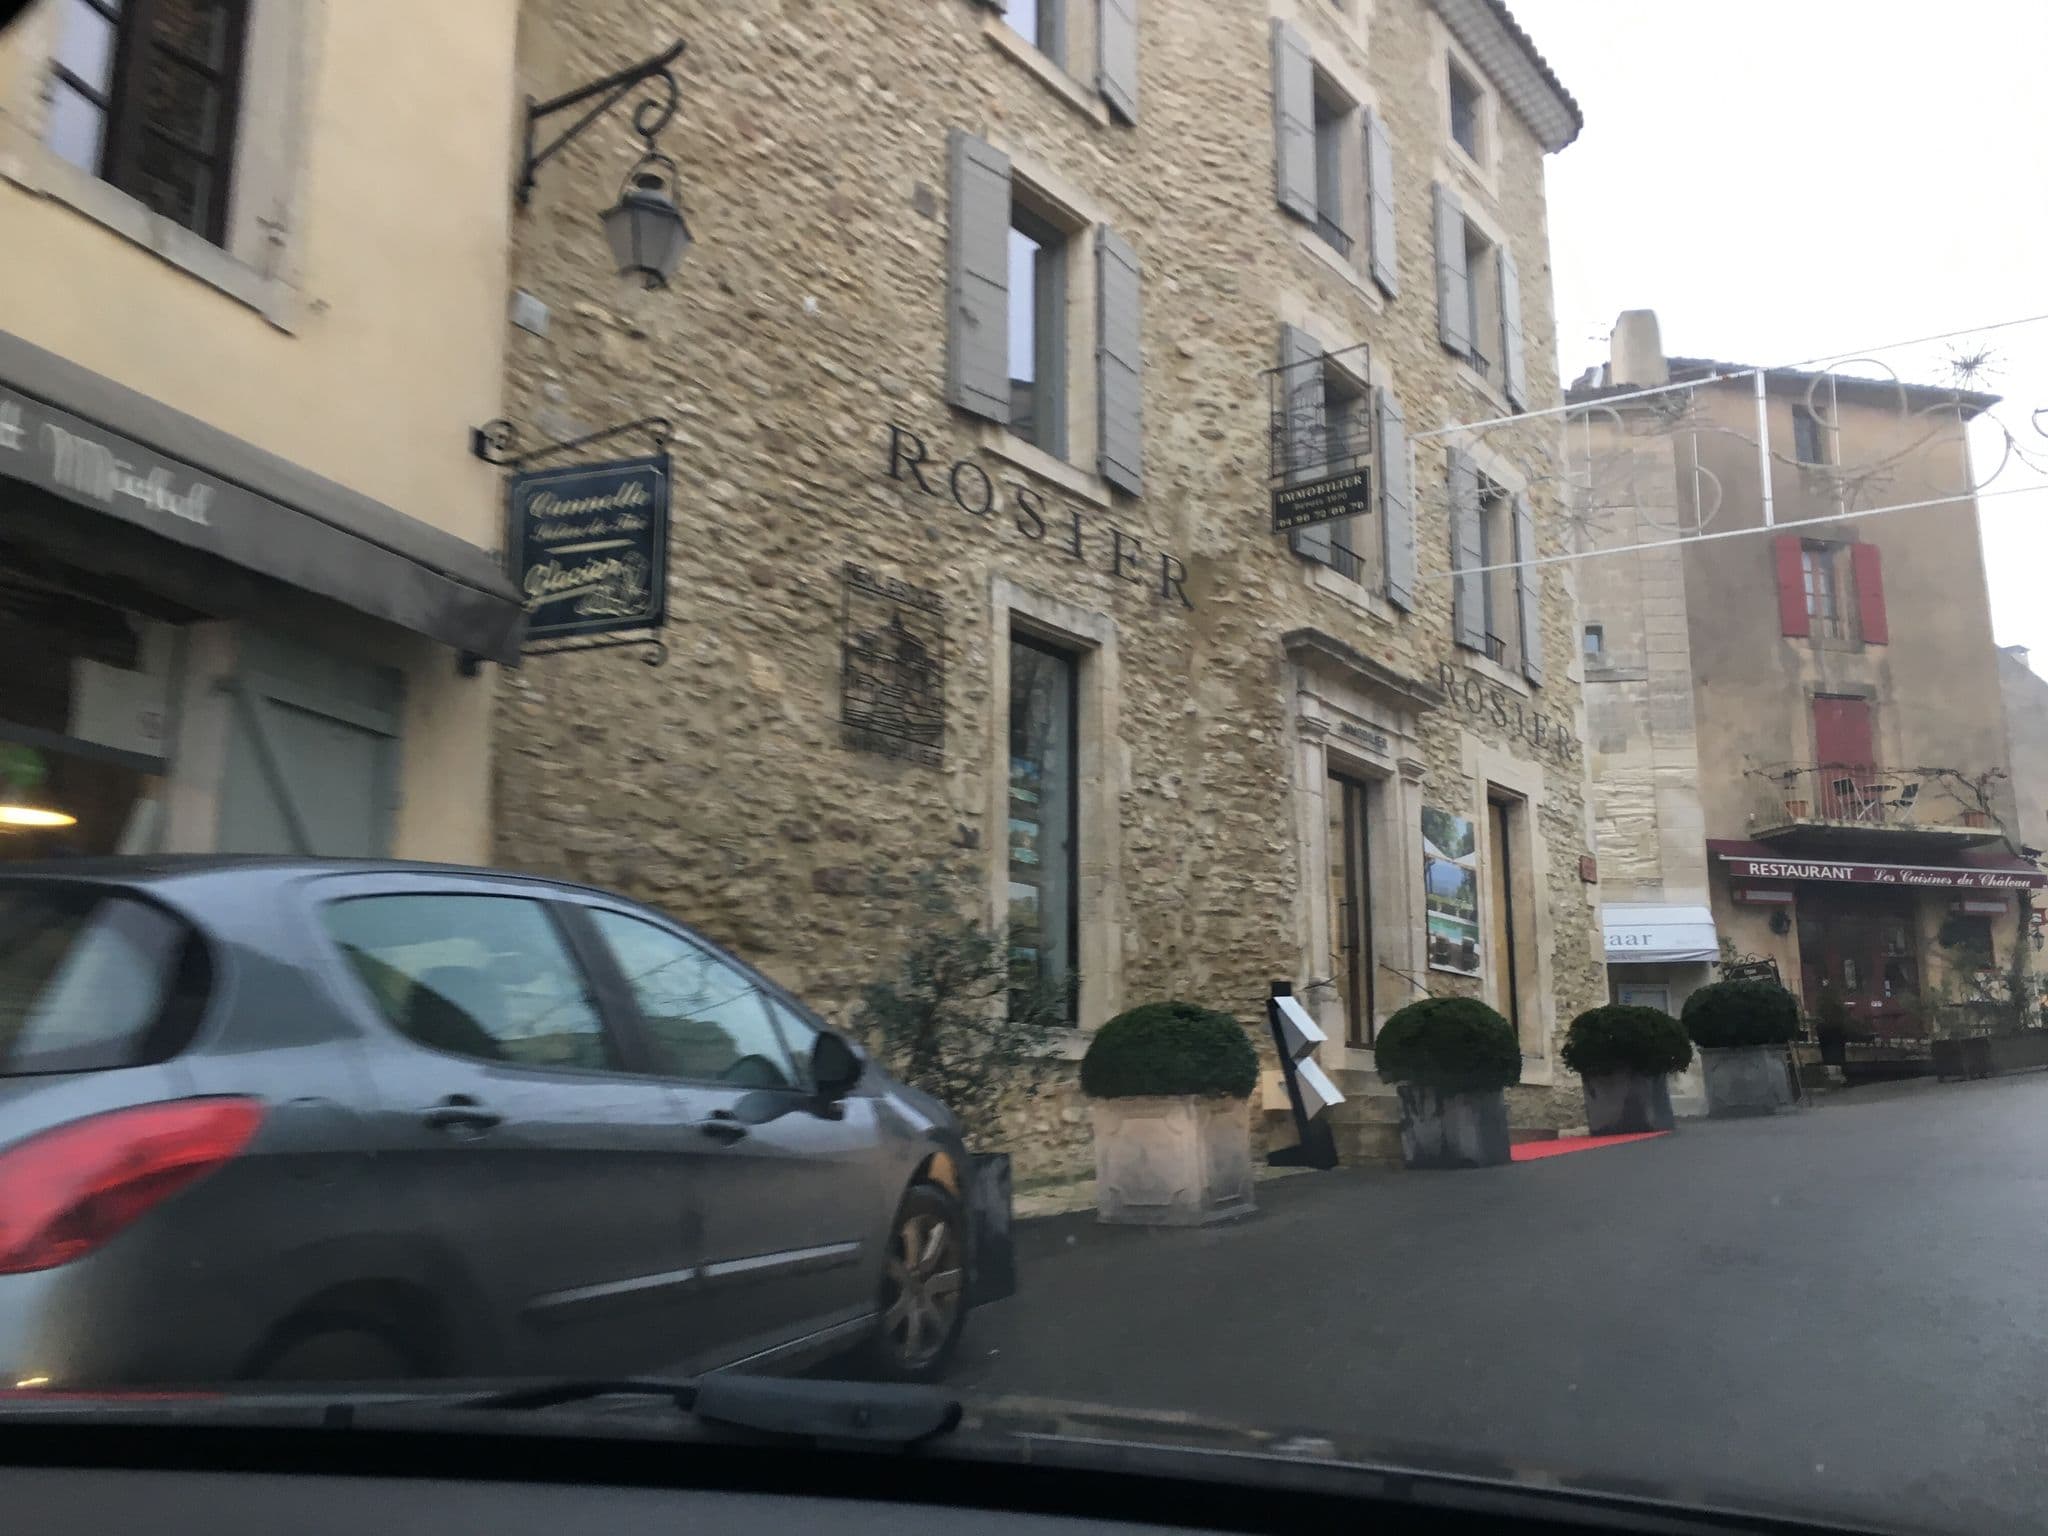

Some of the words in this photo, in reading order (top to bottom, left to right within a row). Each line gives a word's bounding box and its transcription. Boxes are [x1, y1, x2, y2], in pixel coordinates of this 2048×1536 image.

[1280, 475, 1361, 503] IMMOBILIER
[886, 423, 1194, 612] ROSIER
[1440, 662, 1573, 762] ROSIER
[1749, 863, 1854, 880] RESTAURANT
[1873, 868, 1896, 882] Les
[1899, 869, 1952, 885] Cuisines
[1957, 873, 1974, 886] du
[1978, 873, 2031, 888] Château
[1604, 933, 1653, 946] aar
